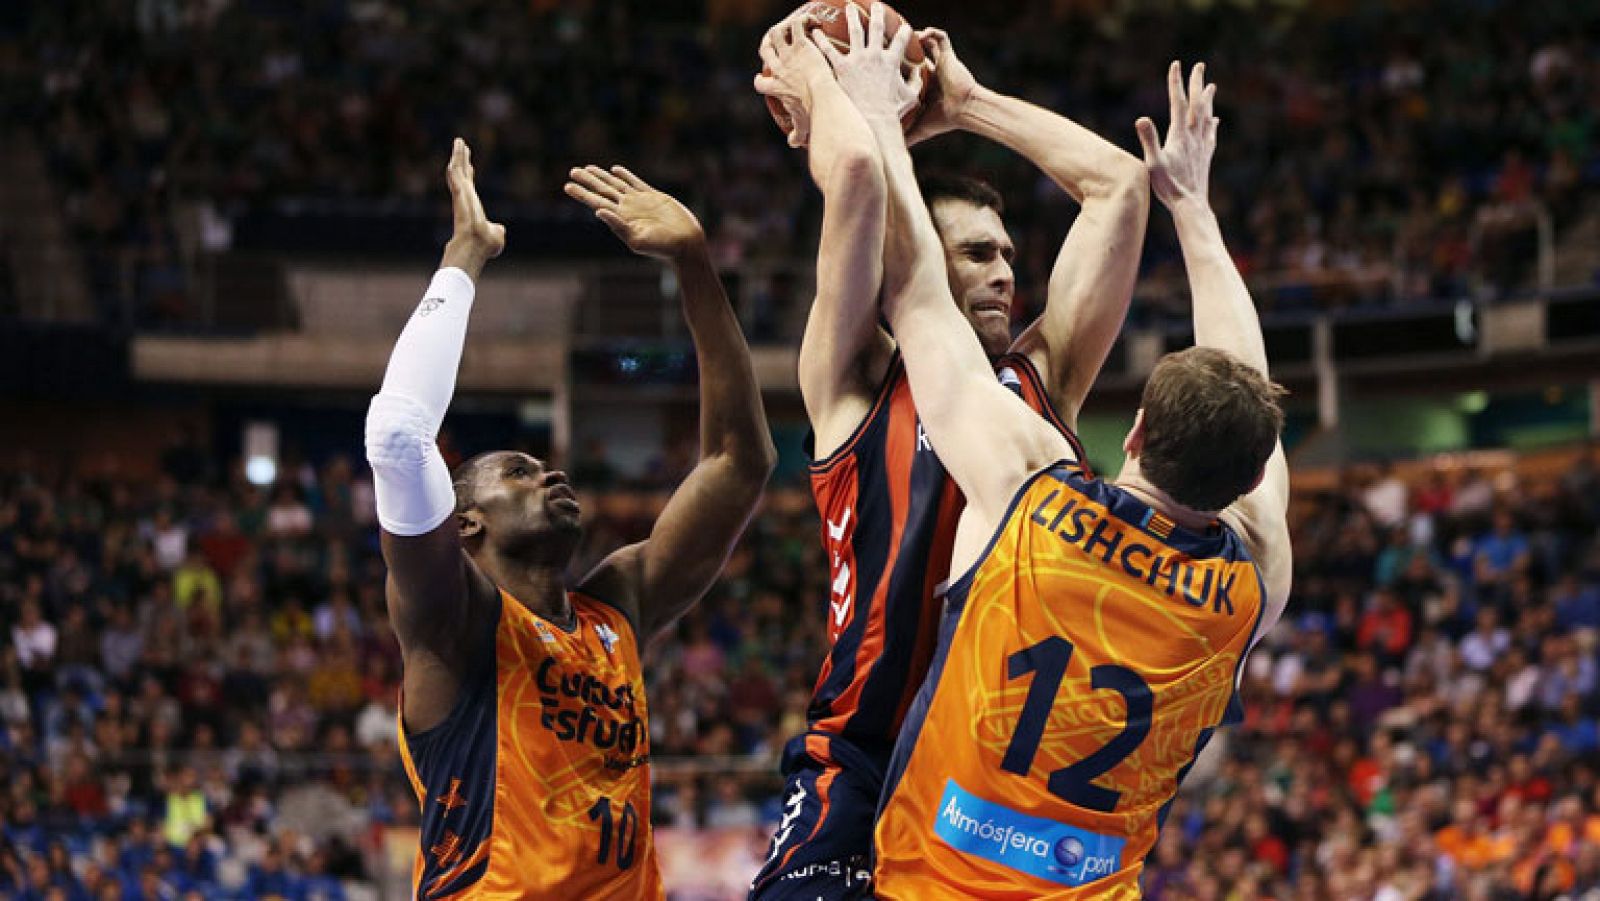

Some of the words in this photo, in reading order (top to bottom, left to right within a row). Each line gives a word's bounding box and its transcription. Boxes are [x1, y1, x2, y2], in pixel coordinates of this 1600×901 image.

[1031, 489, 1236, 616] LISHCHUK
[1000, 636, 1155, 813] 12
[587, 796, 638, 871] 10
[942, 796, 1049, 858] Atmósfera
